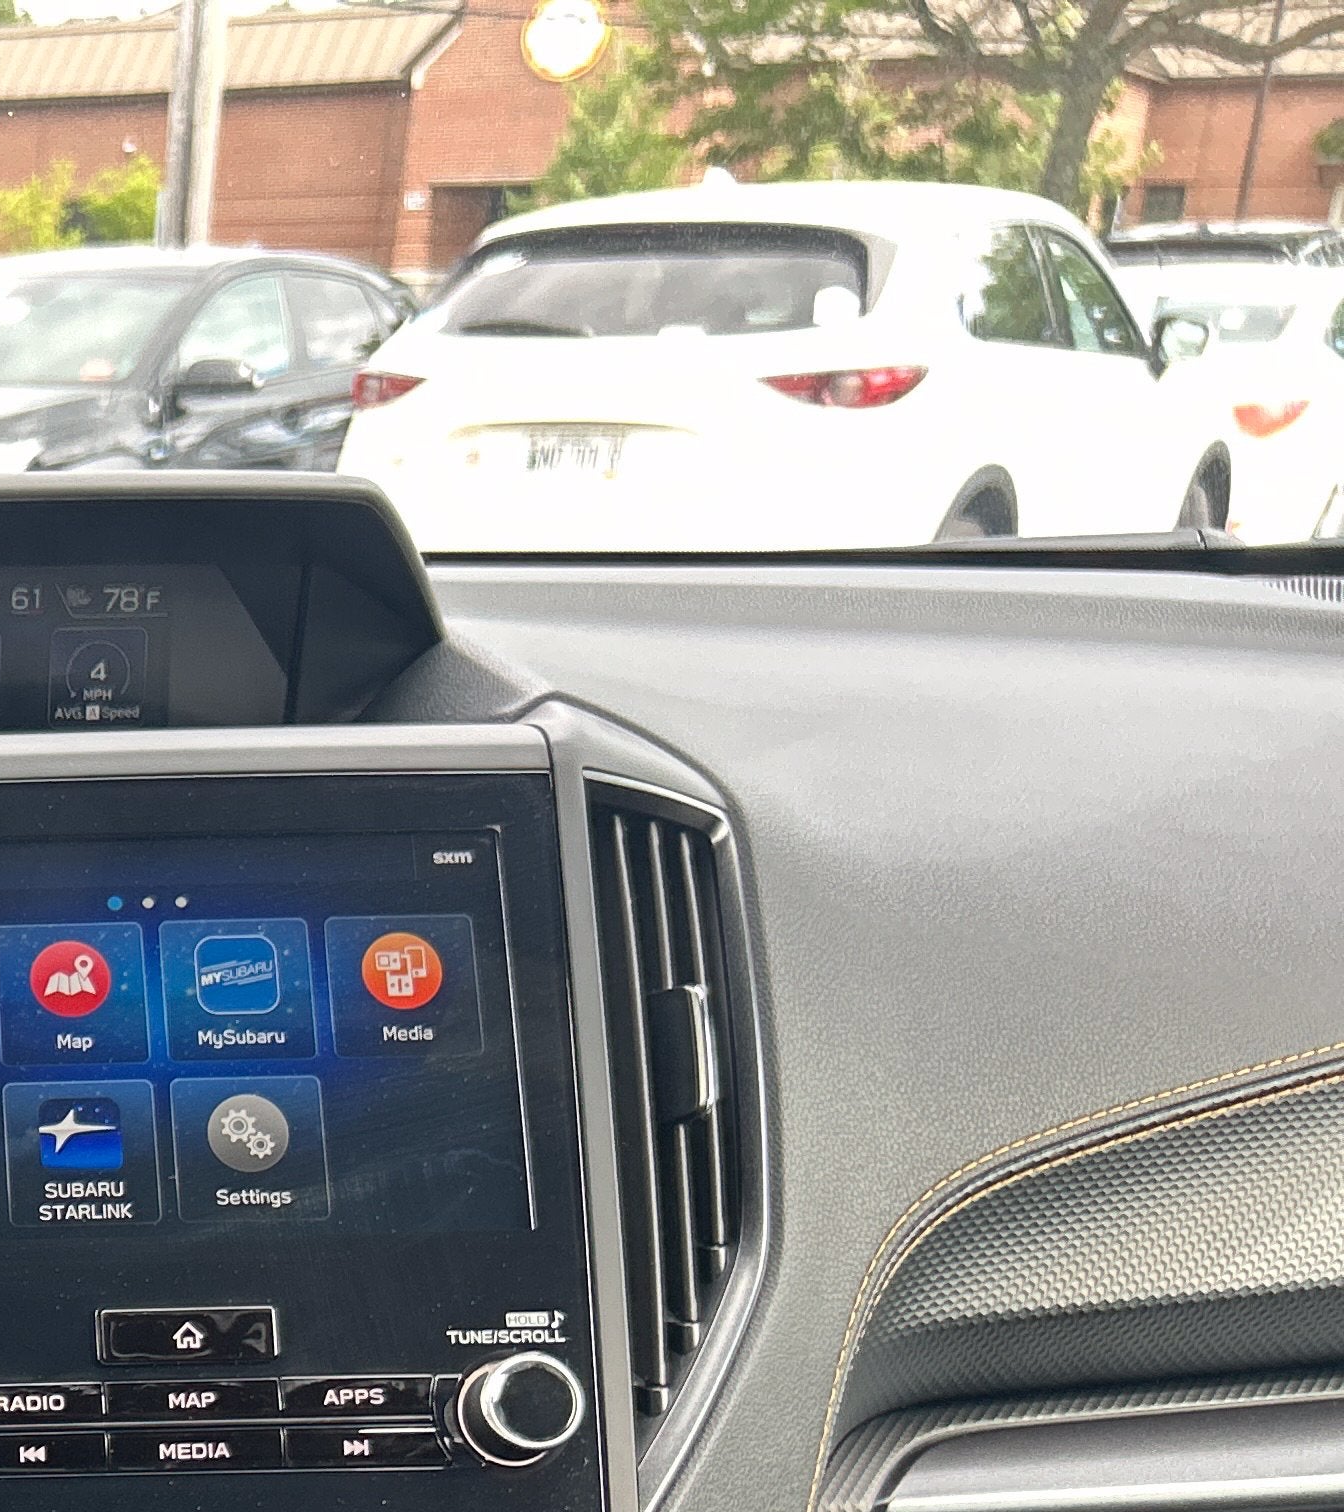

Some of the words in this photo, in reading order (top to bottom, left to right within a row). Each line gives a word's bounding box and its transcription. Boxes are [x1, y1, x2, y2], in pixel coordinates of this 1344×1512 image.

[11, 588, 41, 610] 61
[90, 661, 108, 682] 4
[83, 688, 112, 701] MPH
[433, 850, 472, 865] sxm
[201, 961, 273, 986] MYSUBARU
[197, 1029, 286, 1049] MySubaru
[382, 1024, 433, 1041] Media
[56, 1034, 93, 1053] Map
[44, 1180, 125, 1199] SUBARU
[215, 1186, 292, 1209] Settings
[39, 1202, 133, 1221] STARLINK
[507, 1315, 546, 1325] HOLD
[446, 1329, 566, 1344] TUNE/SCROLL
[168, 1391, 216, 1409] MAP
[323, 1387, 385, 1406] APPS
[158, 1440, 231, 1461] MEDIA
